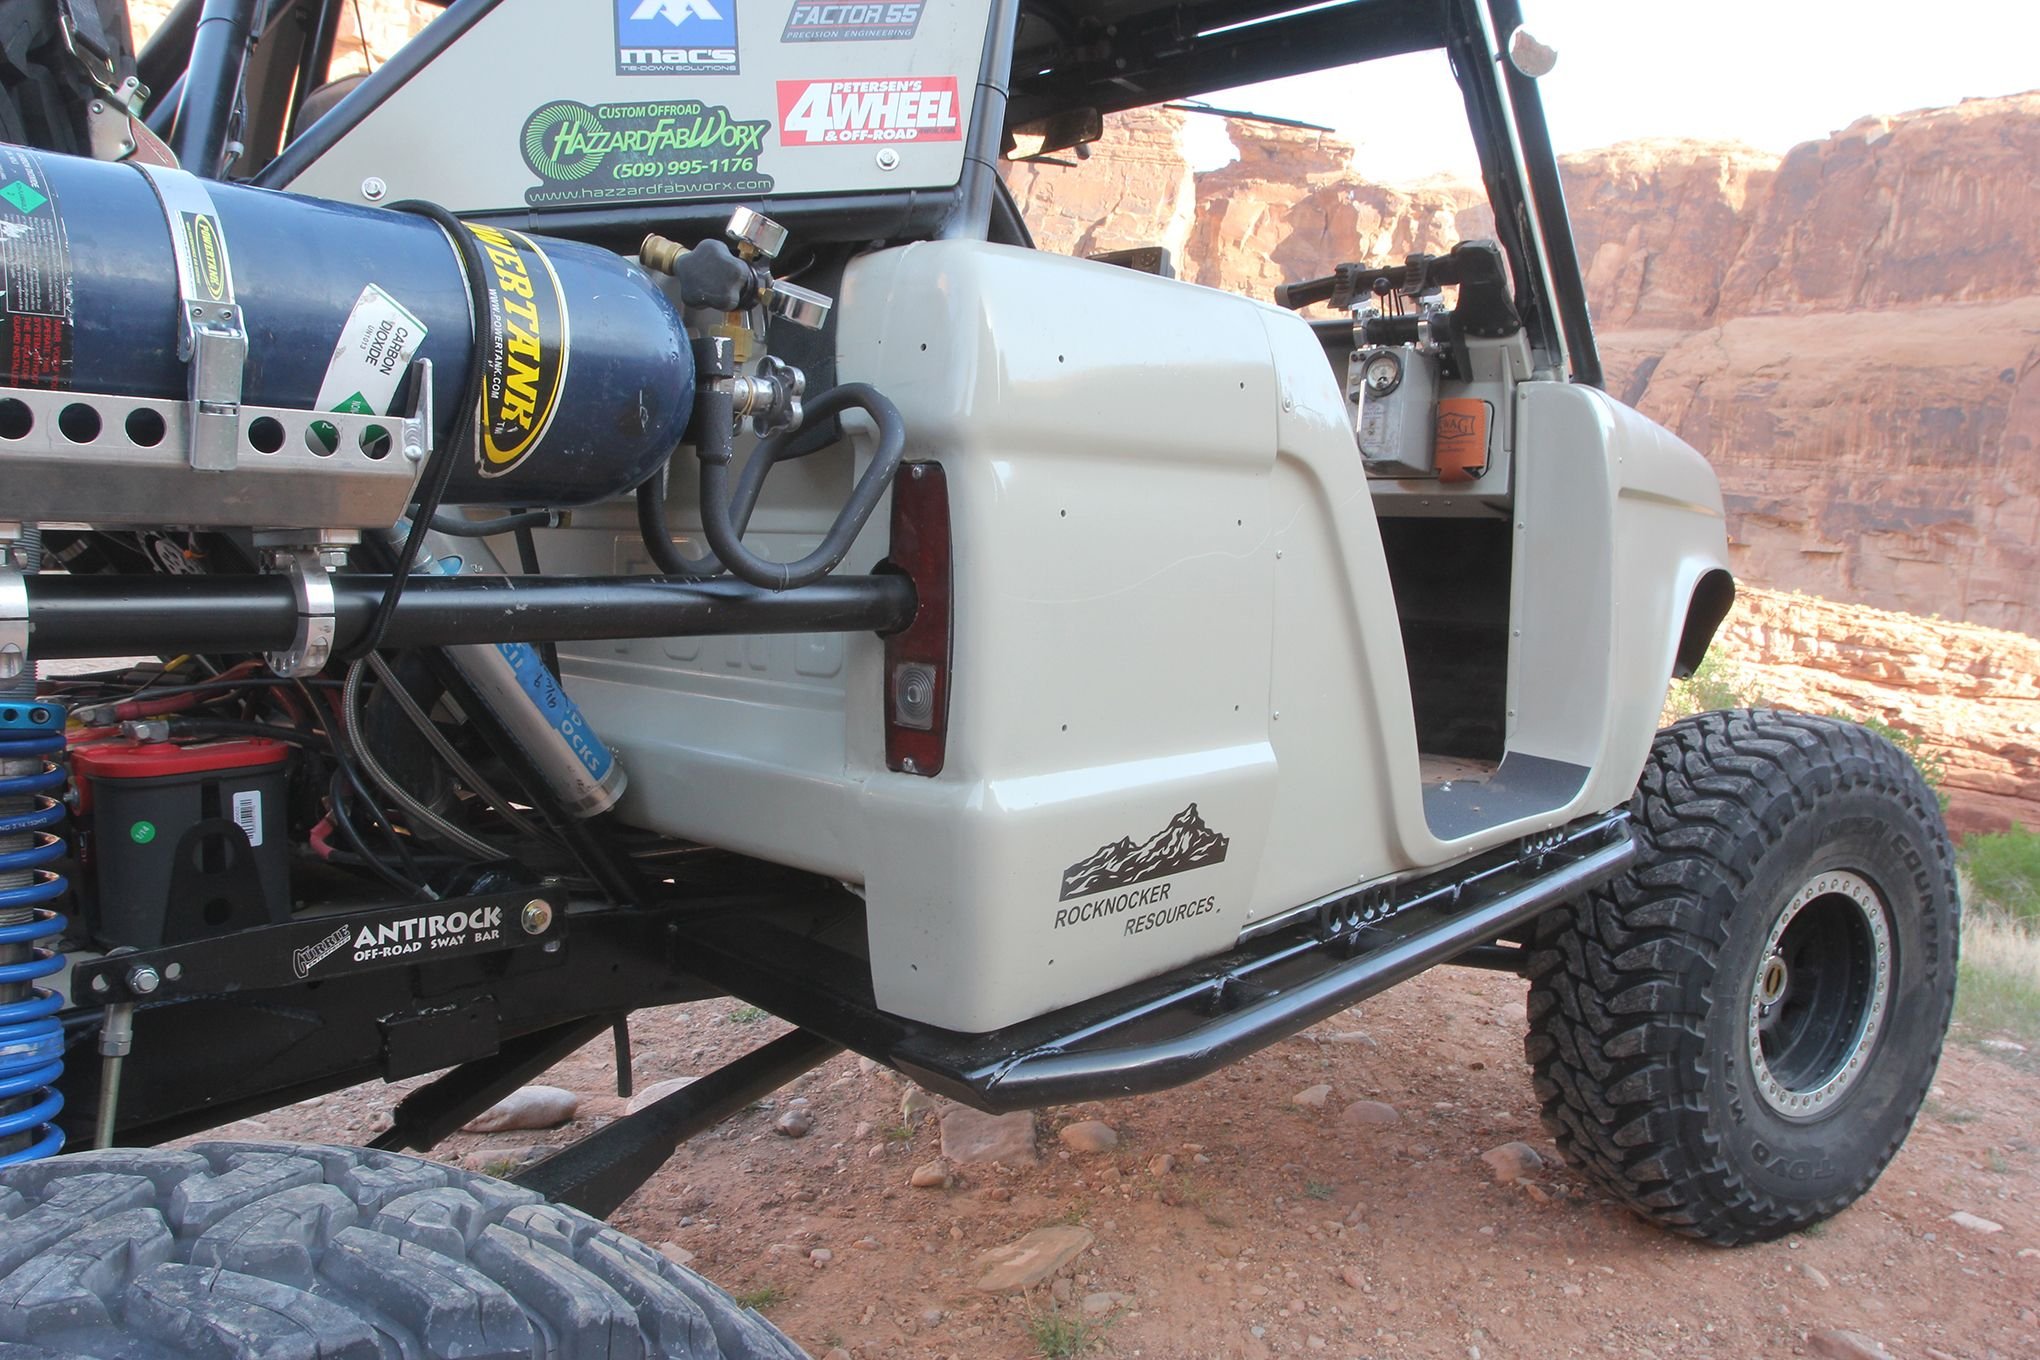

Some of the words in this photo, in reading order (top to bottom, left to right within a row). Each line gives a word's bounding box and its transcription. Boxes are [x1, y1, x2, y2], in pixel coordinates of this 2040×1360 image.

[792, 4, 882, 24] FACTOR
[885, 2, 918, 24] 55
[787, 29, 839, 39] PRECISION
[844, 28, 913, 38] ENGINEERING
[676, 64, 737, 72] SOLUTIONS
[832, 80, 922, 93] PETERSEN'S
[598, 104, 646, 119] CUSTOM
[647, 102, 701, 117] OFFROAD
[784, 83, 833, 142] 4
[830, 91, 957, 129] WHEEL
[825, 130, 837, 142] &
[837, 128, 918, 142] OFF-ROAD
[612, 161, 664, 180] (509)
[667, 157, 754, 176] 995-1176
[529, 178, 771, 203] www.hazzardfabworx.com
[365, 319, 393, 367] DIOXIDE
[379, 327, 409, 376] CARBON
[488, 288, 505, 399] WWW.POWERTANK.COM
[1054, 883, 1171, 929] ROCKNOCKER
[1890, 832, 1939, 993] COUNTRY
[353, 905, 501, 949] ANTIROCK
[353, 941, 422, 962] OFF-ROAD
[430, 934, 467, 949] SWAY
[474, 929, 500, 943] BAR
[1750, 1139, 1836, 1180] TOYO
